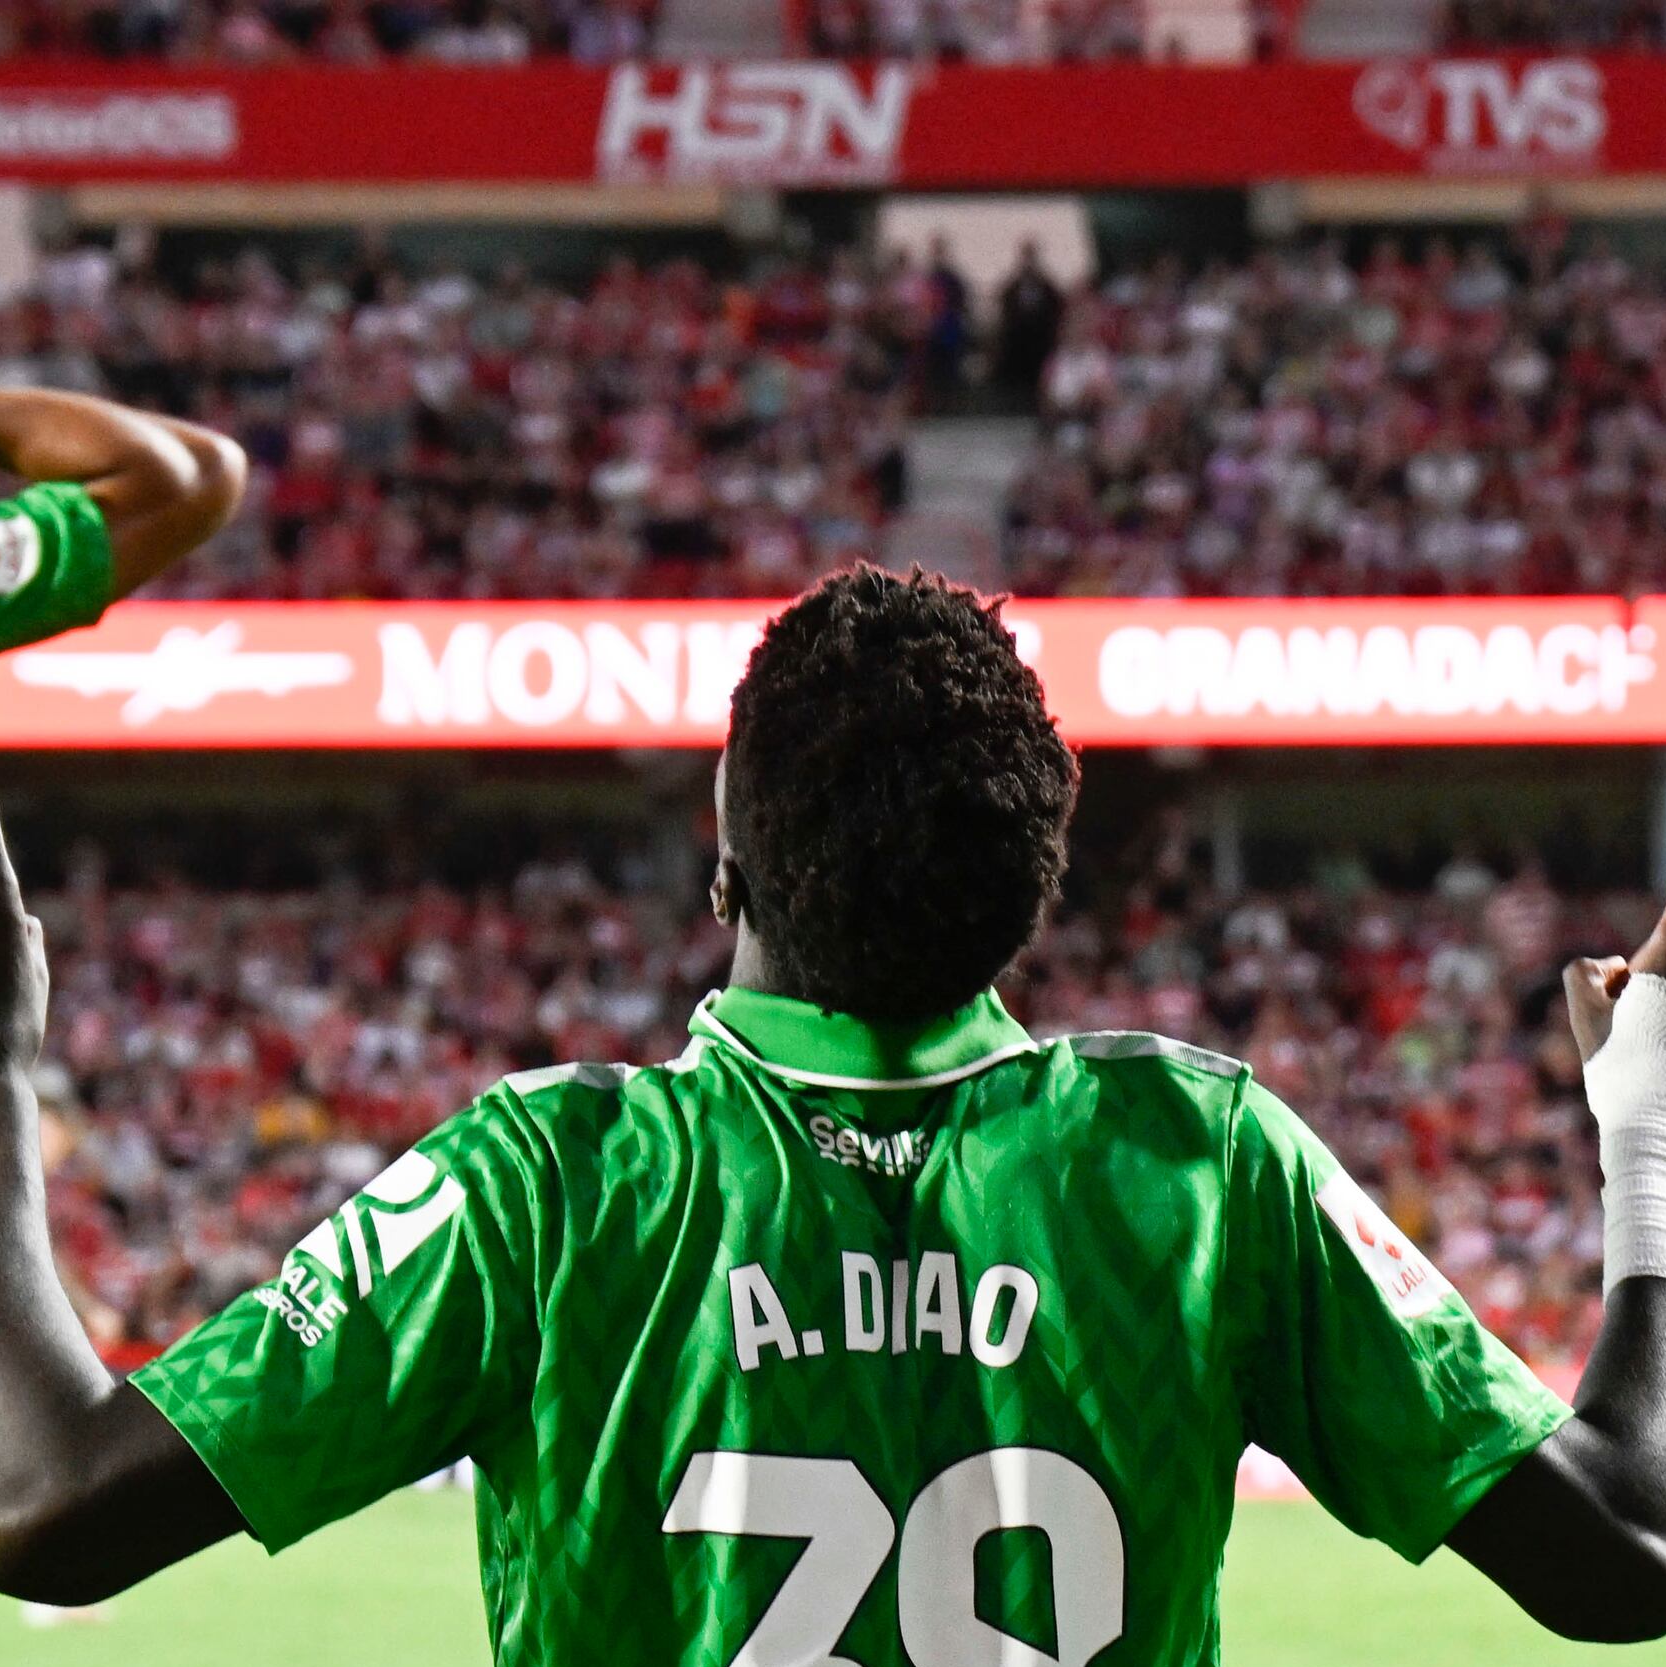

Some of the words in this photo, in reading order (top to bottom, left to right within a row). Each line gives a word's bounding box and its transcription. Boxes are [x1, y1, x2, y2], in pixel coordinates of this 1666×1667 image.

[597, 60, 911, 164] HSN
[1431, 58, 1607, 152] TVS
[376, 620, 763, 727] MONK
[282, 1264, 349, 1332] ALE
[728, 1262, 825, 1372] A.
[841, 1250, 1039, 1368] DIAO
